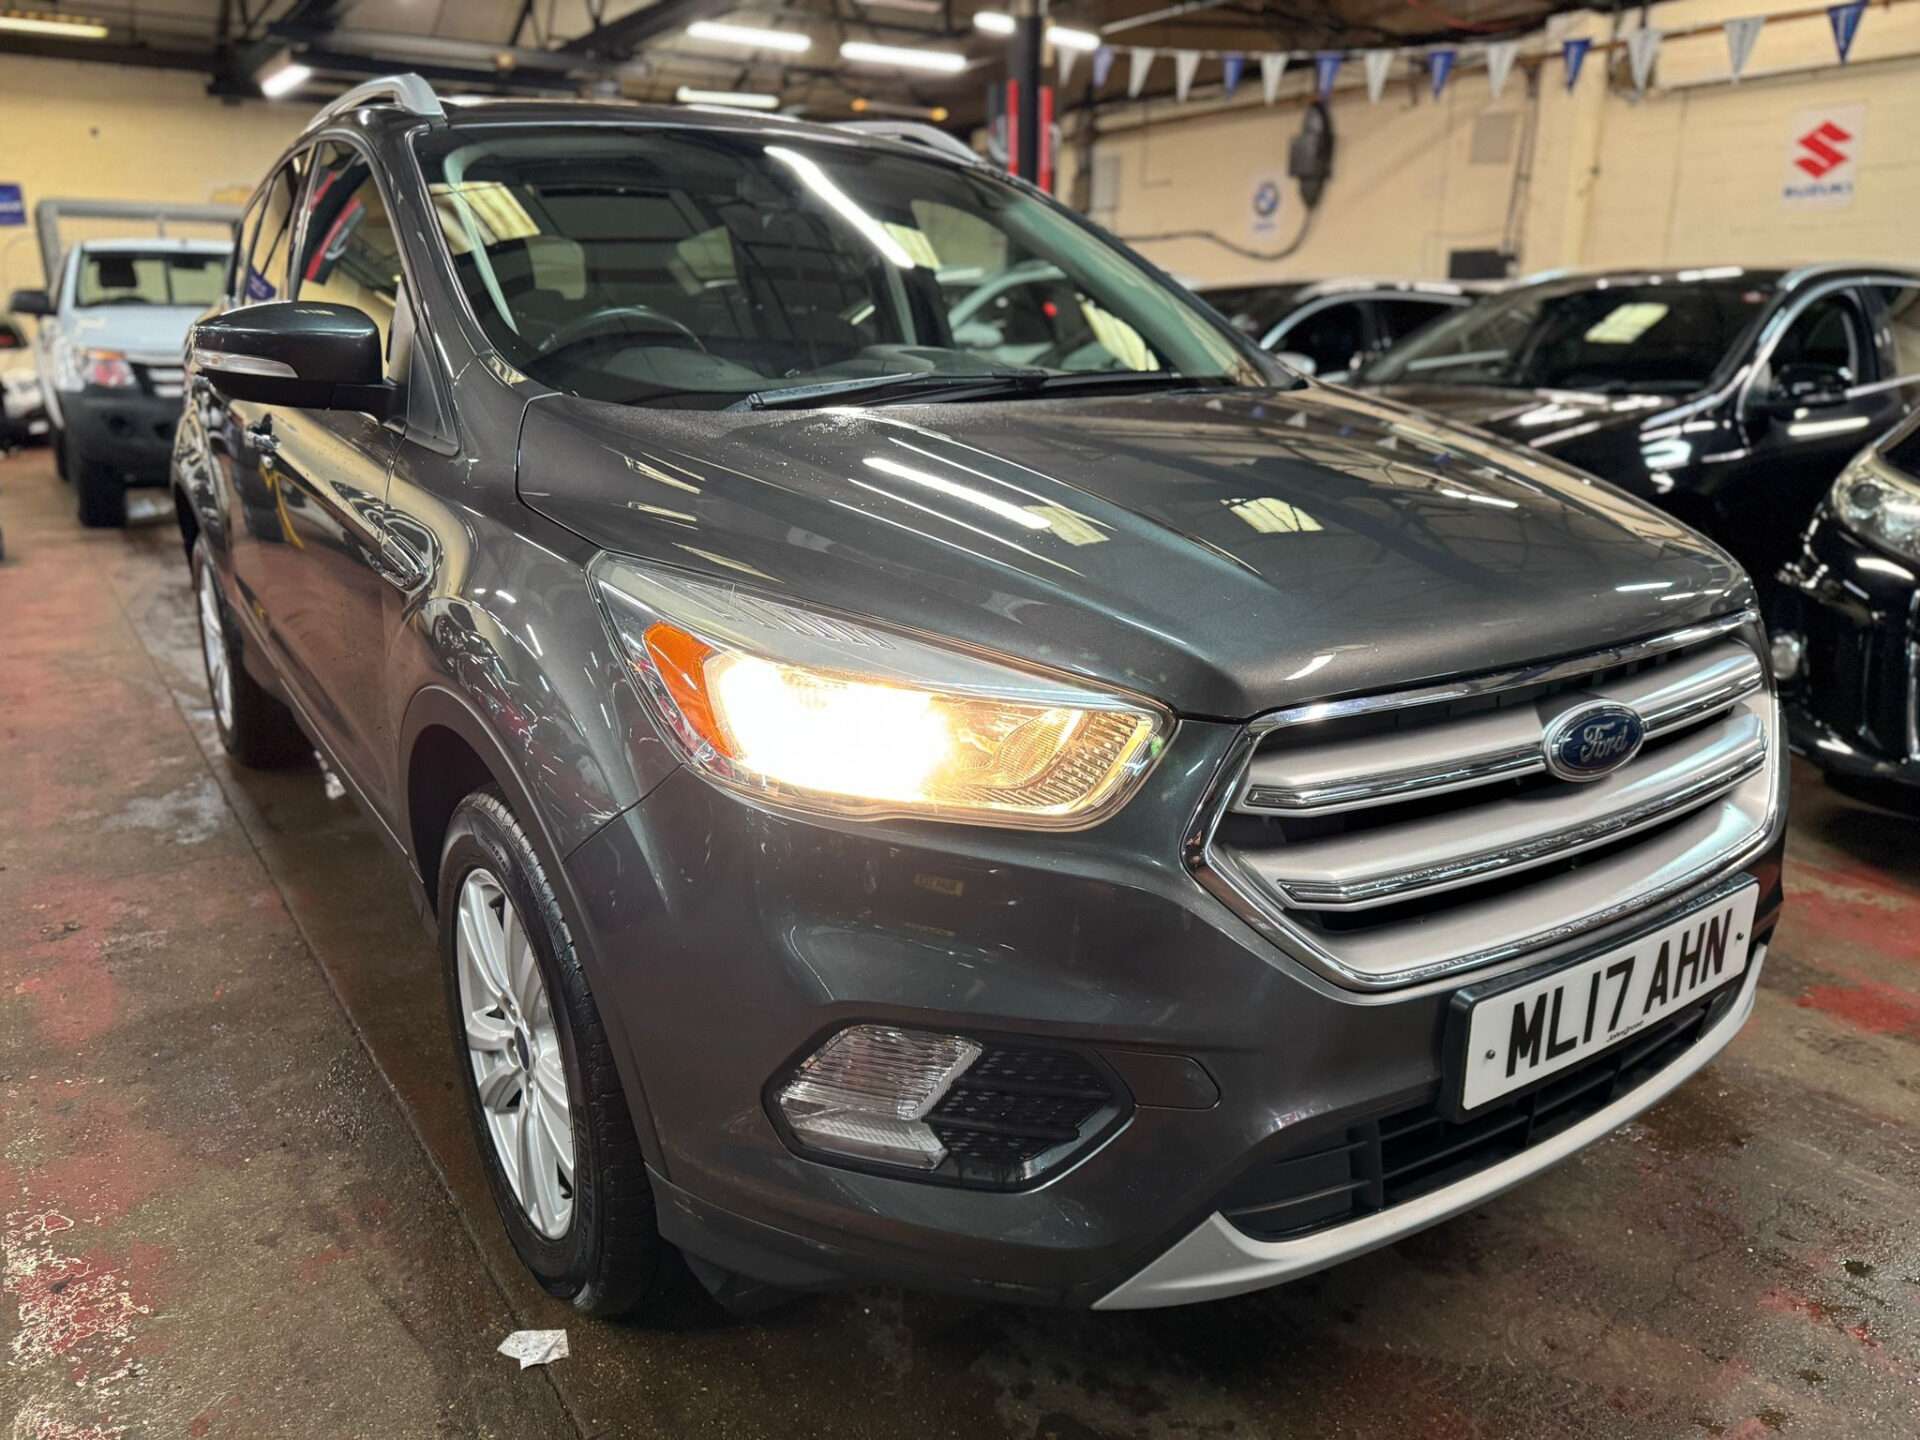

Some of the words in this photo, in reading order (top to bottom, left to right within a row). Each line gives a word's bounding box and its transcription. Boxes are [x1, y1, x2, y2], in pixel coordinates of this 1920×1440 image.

[1581, 719, 1629, 762] Ford
[1505, 956, 1635, 1078] ML17
[1642, 908, 1733, 1015] AHN
